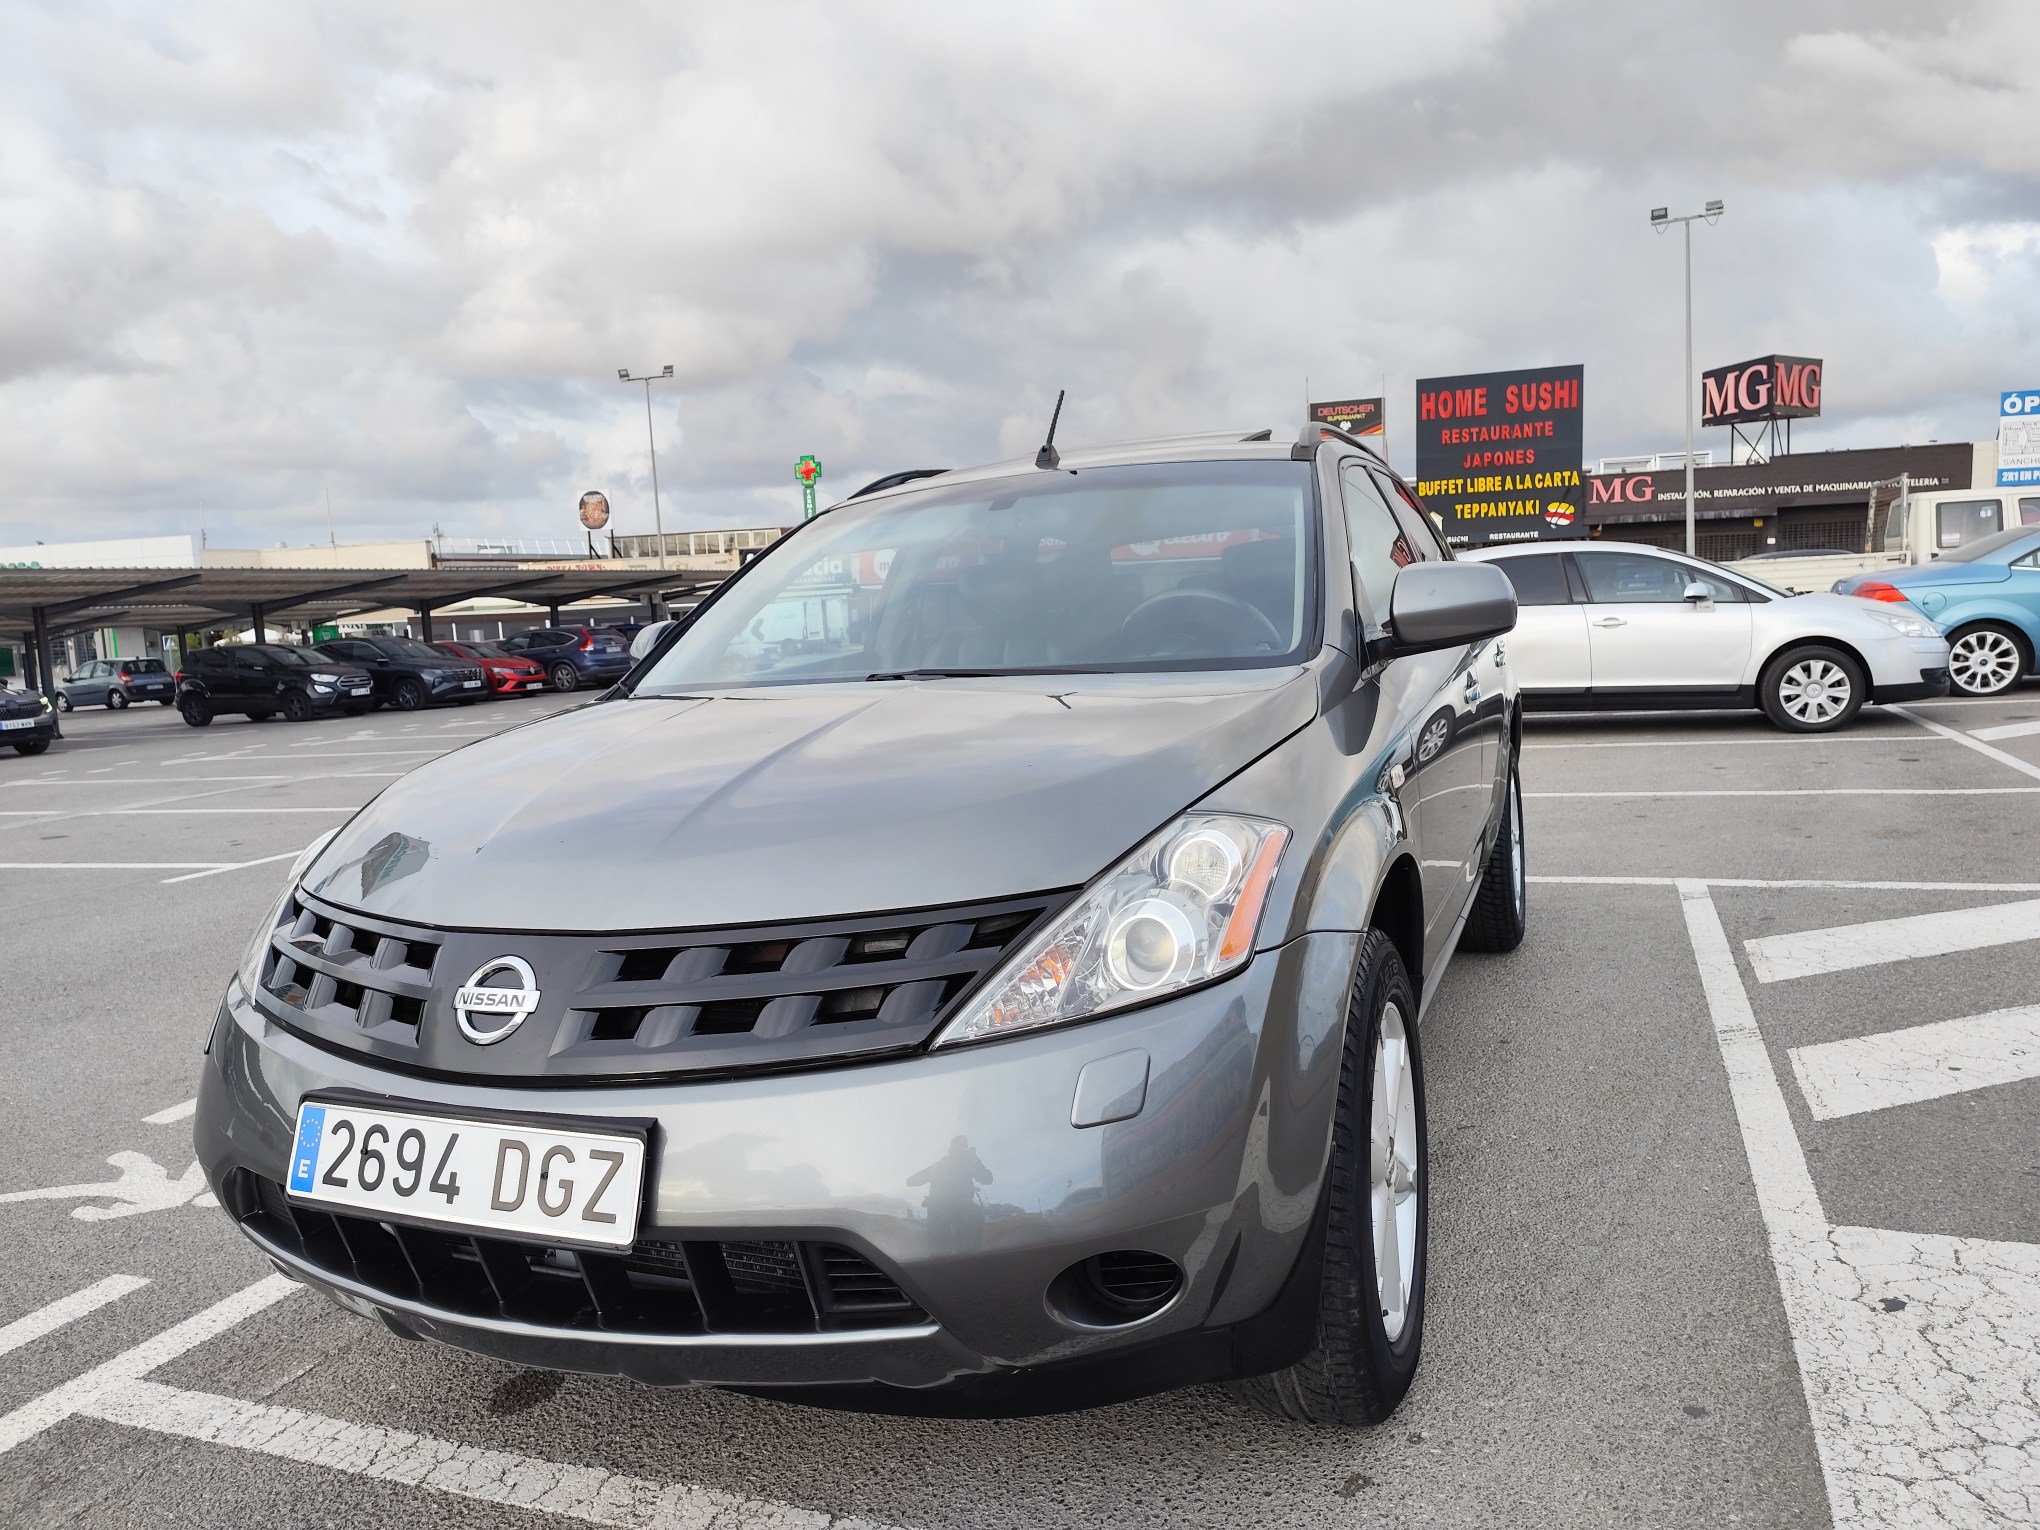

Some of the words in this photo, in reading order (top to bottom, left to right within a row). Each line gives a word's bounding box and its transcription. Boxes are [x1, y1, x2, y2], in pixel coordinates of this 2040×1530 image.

[1702, 364, 1772, 419] MG
[1775, 362, 1821, 408] MG
[1317, 403, 1375, 417] DEUTSCHER
[1421, 387, 1488, 421] HOME
[1505, 379, 1578, 414] SUSHI
[1326, 413, 1367, 421] SUPERMARKT
[1441, 421, 1553, 444] RESTAURANTE
[1463, 449, 1535, 468] JAPONES
[1418, 478, 1464, 497] BUFFET
[1466, 475, 1502, 493] LIBRE
[1504, 475, 1513, 491] A
[1516, 473, 1532, 490] LA
[1534, 470, 1580, 488] CARTA
[1589, 475, 1656, 504] MG
[1657, 489, 1712, 501] INSTALAIÓN,
[1714, 485, 1765, 498] REPARACIÓN
[1767, 487, 1773, 495] Y
[1774, 485, 1801, 494] VENTA
[1803, 484, 1814, 493] DE
[1815, 481, 1872, 492] MAQUINARIA
[1455, 500, 1540, 519] TEPPANYAKI
[1489, 531, 1539, 540] RESTAURANTE
[458, 990, 526, 1008] NISSAN
[298, 1159, 311, 1179] E
[322, 1118, 461, 1205] 2694
[490, 1137, 624, 1225] DGZ
